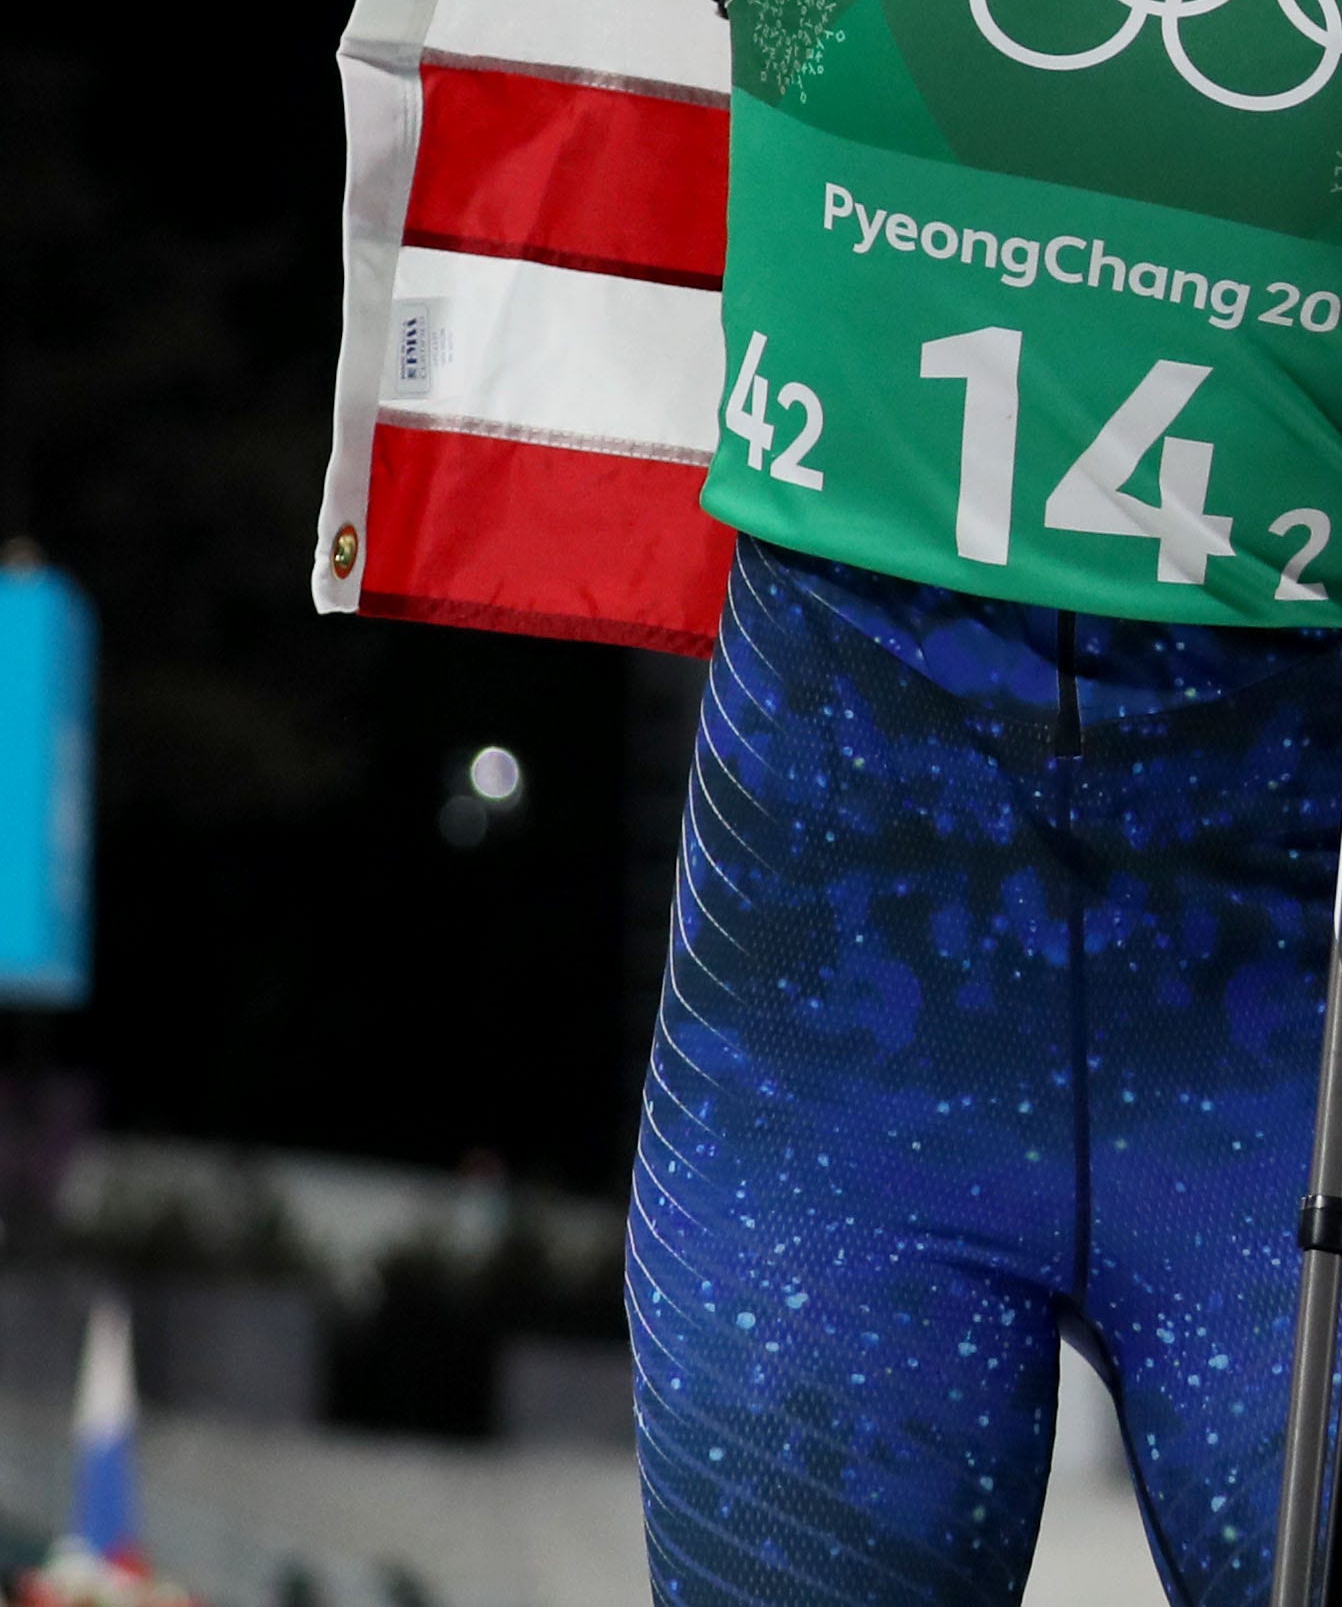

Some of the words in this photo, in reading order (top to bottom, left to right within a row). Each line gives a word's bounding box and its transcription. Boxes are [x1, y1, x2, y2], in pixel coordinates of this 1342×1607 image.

[823, 183, 1250, 330] PyeongChang
[919, 325, 1237, 586] 14
[1266, 508, 1332, 602] 2
